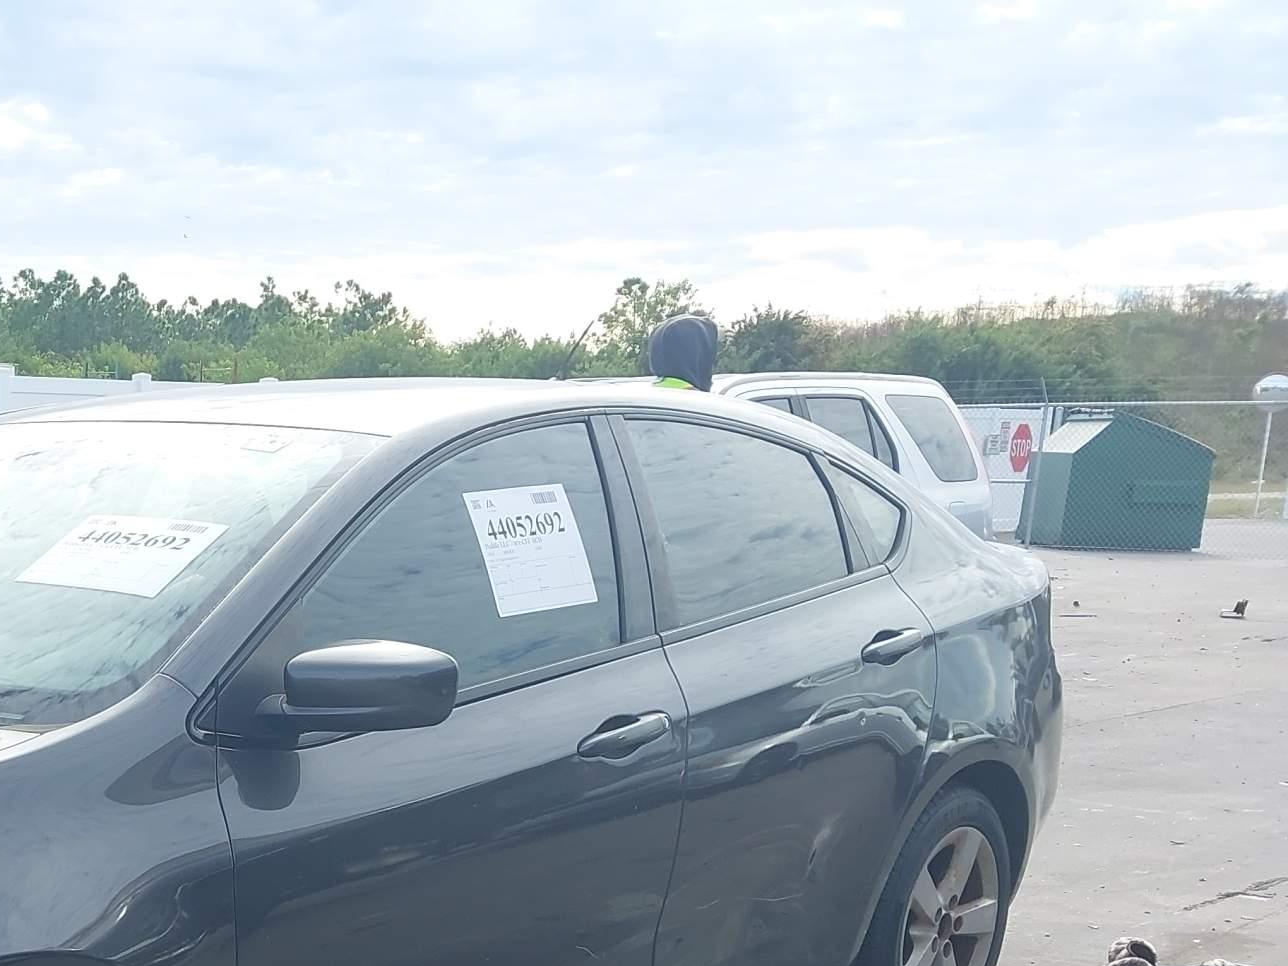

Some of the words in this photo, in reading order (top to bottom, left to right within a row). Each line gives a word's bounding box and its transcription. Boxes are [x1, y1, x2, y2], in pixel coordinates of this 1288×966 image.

[1012, 440, 1031, 457] STOP
[487, 511, 566, 540] 44052692
[78, 529, 192, 550] 44052692
